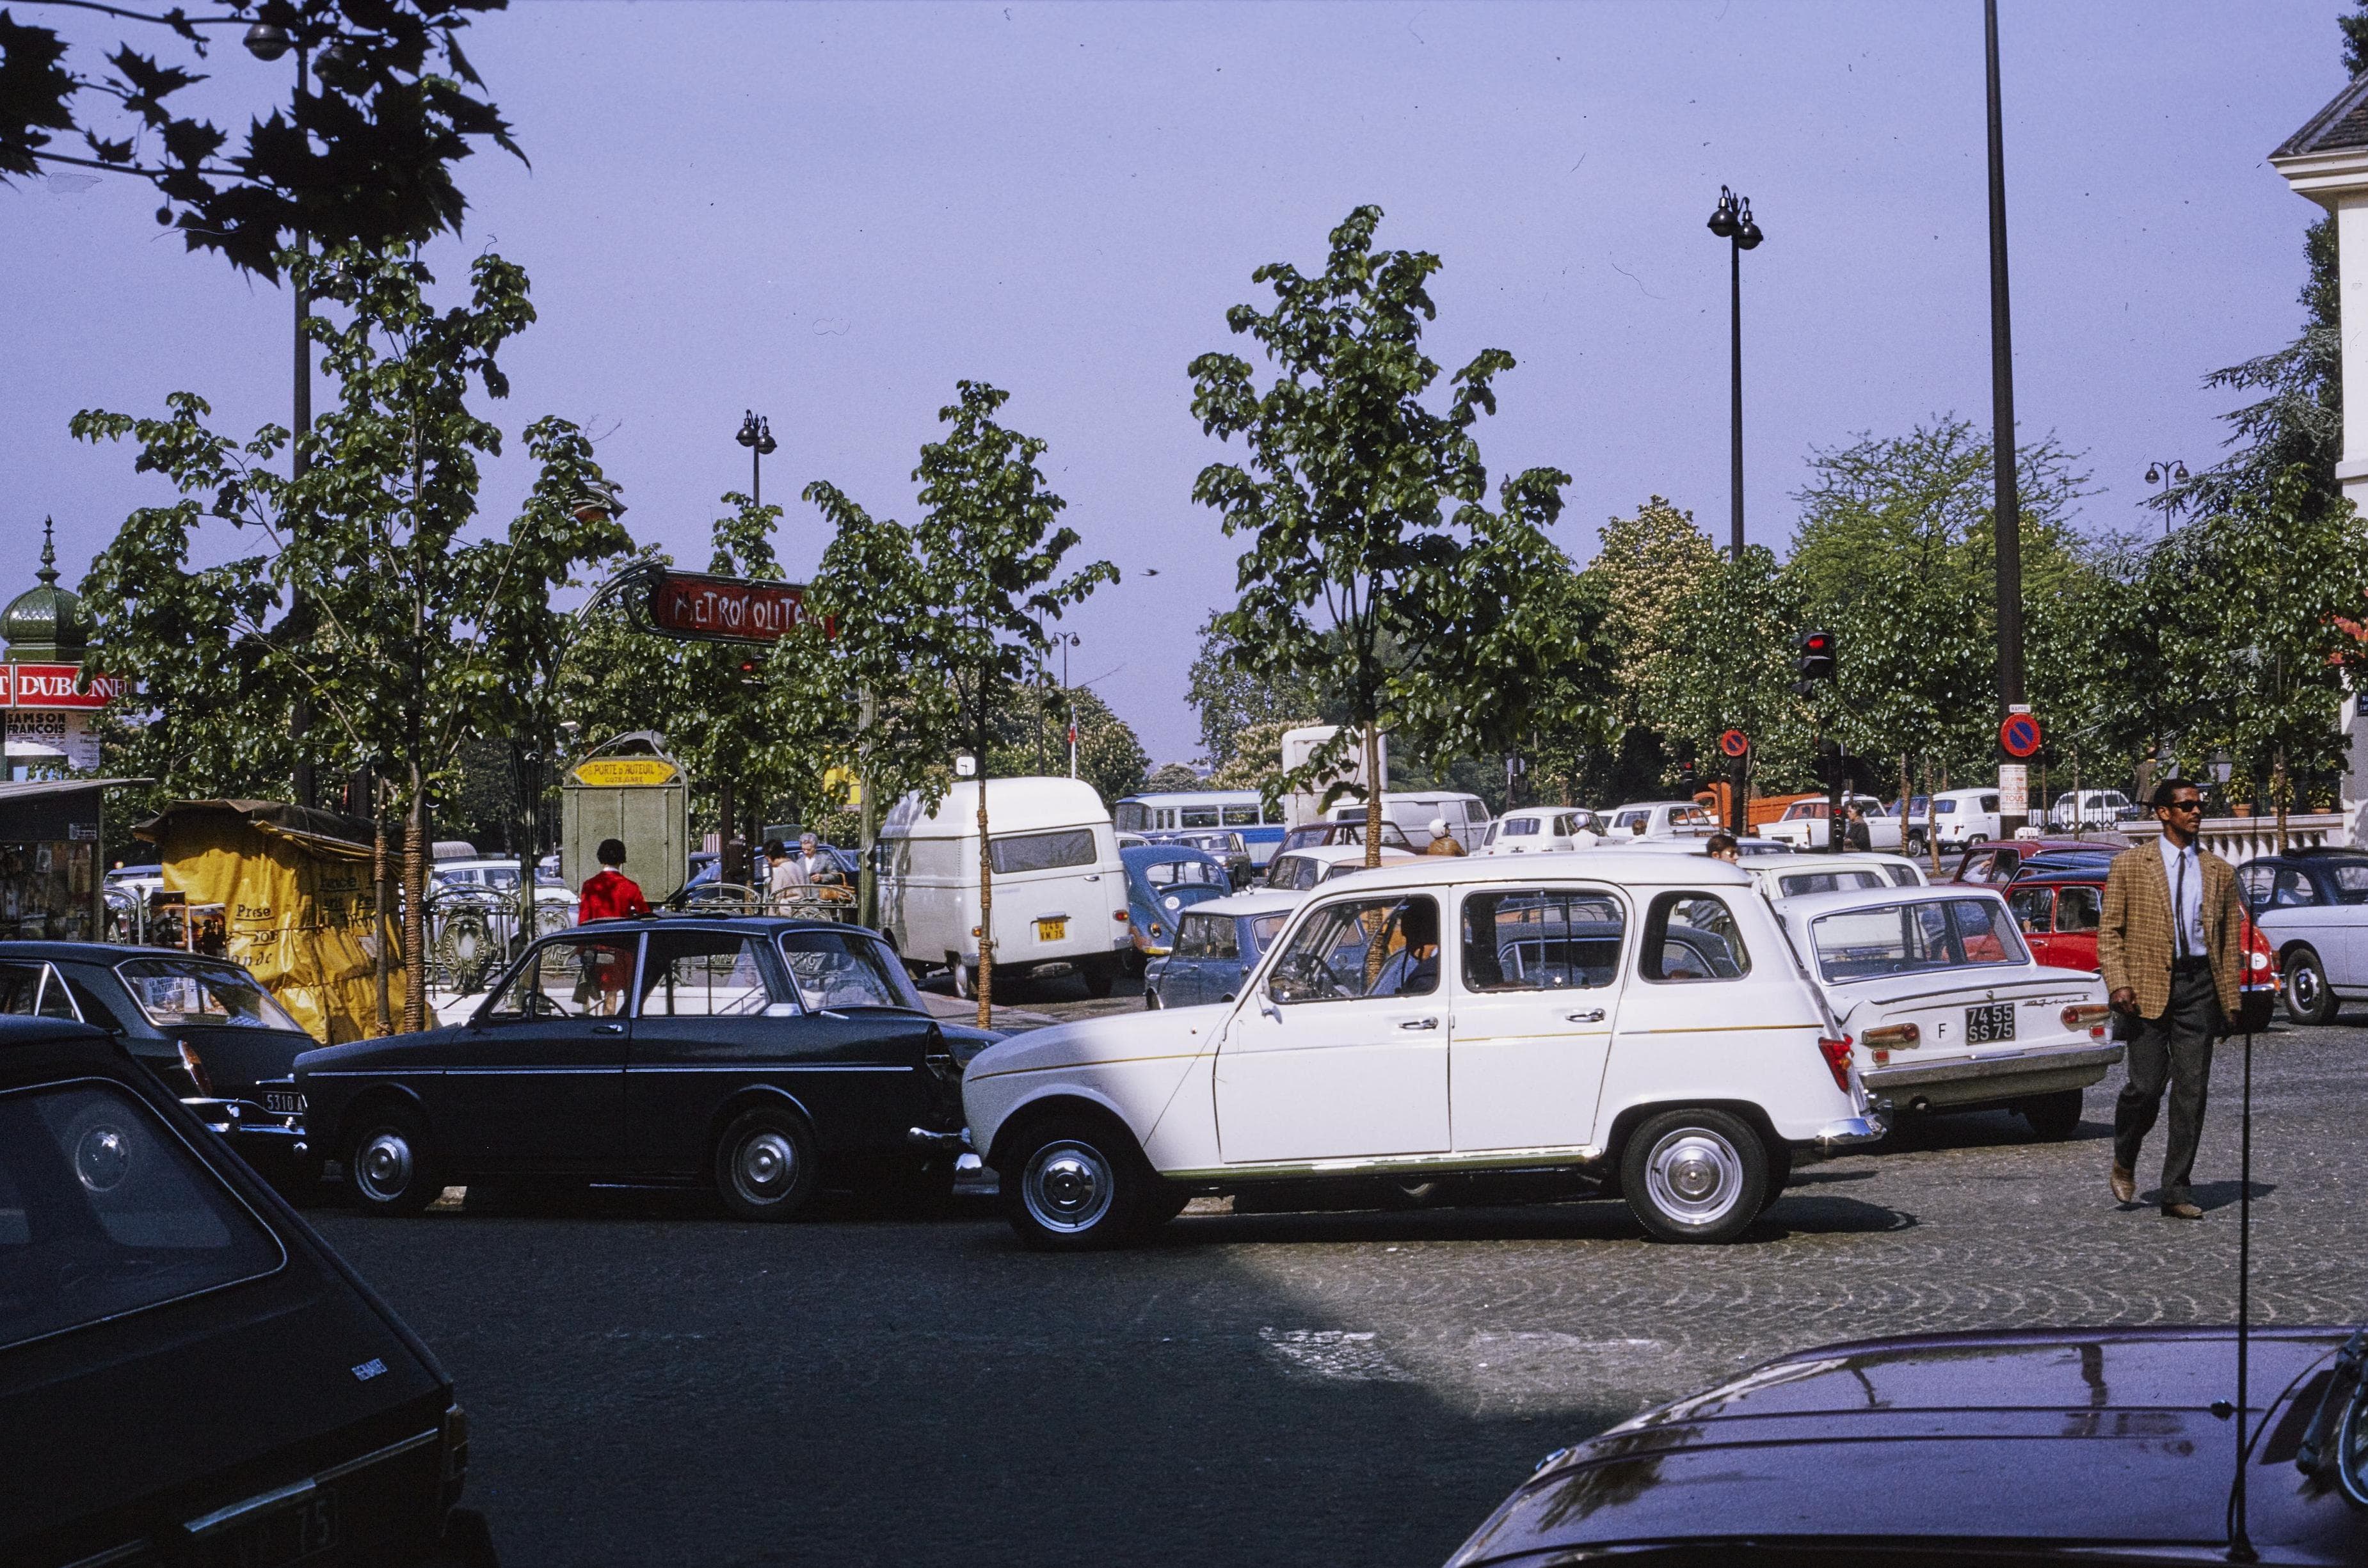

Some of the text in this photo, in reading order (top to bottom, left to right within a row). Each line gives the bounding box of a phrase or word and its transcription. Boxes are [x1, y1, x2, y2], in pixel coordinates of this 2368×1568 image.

[7, 713, 66, 723] SAMSON
[594, 764, 616, 775] PORTE
[1938, 1023, 1946, 1039] F
[1969, 1022, 2013, 1042] SS 75
[267, 1094, 294, 1111] 5310
